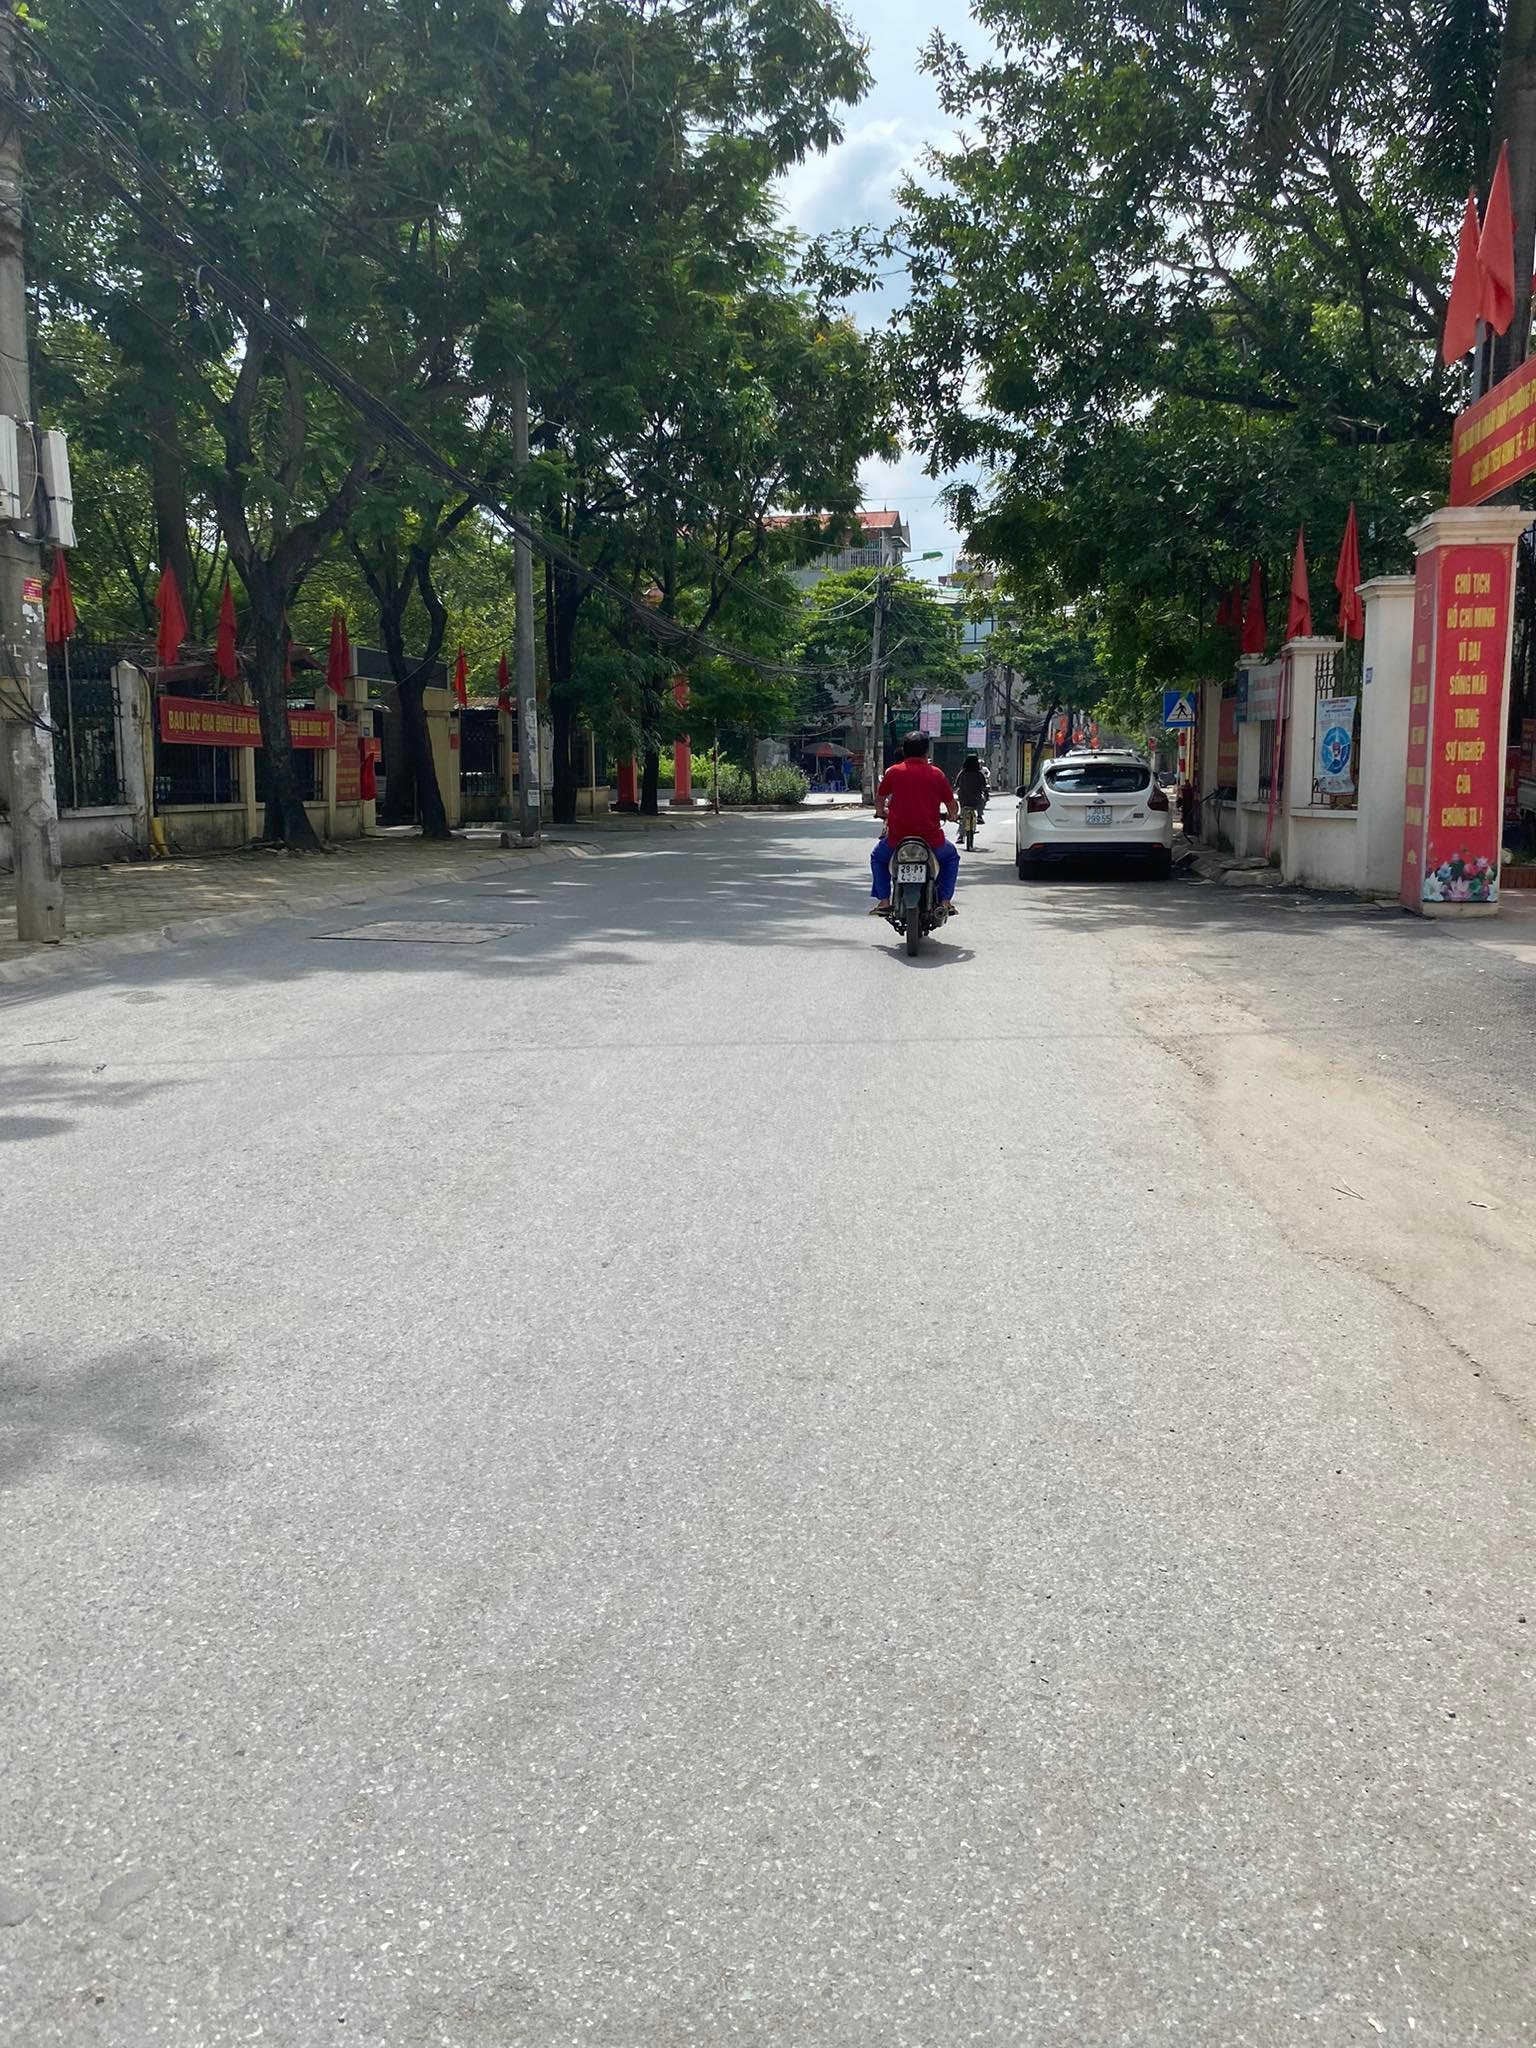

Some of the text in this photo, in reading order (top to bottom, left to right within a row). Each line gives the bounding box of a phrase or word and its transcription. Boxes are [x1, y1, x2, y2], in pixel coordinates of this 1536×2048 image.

[1454, 566, 1491, 598] CHỦ TỊCH
[1447, 602, 1496, 629] HỒ CHÍ MINH
[1458, 638, 1468, 662] VĨ
[1468, 640, 1481, 667] ĐẠI
[1449, 668, 1471, 695] SỐNG
[168, 710, 185, 733] BẠO
[186, 710, 200, 736] LỰC
[201, 713, 215, 732] GIA
[1454, 707, 1480, 729] TRONG
[1445, 740, 1457, 766] SỰ
[1457, 737, 1486, 766] NGHIỆP
[1455, 767, 1471, 795] CỦA
[1441, 803, 1468, 828] CHÚNG
